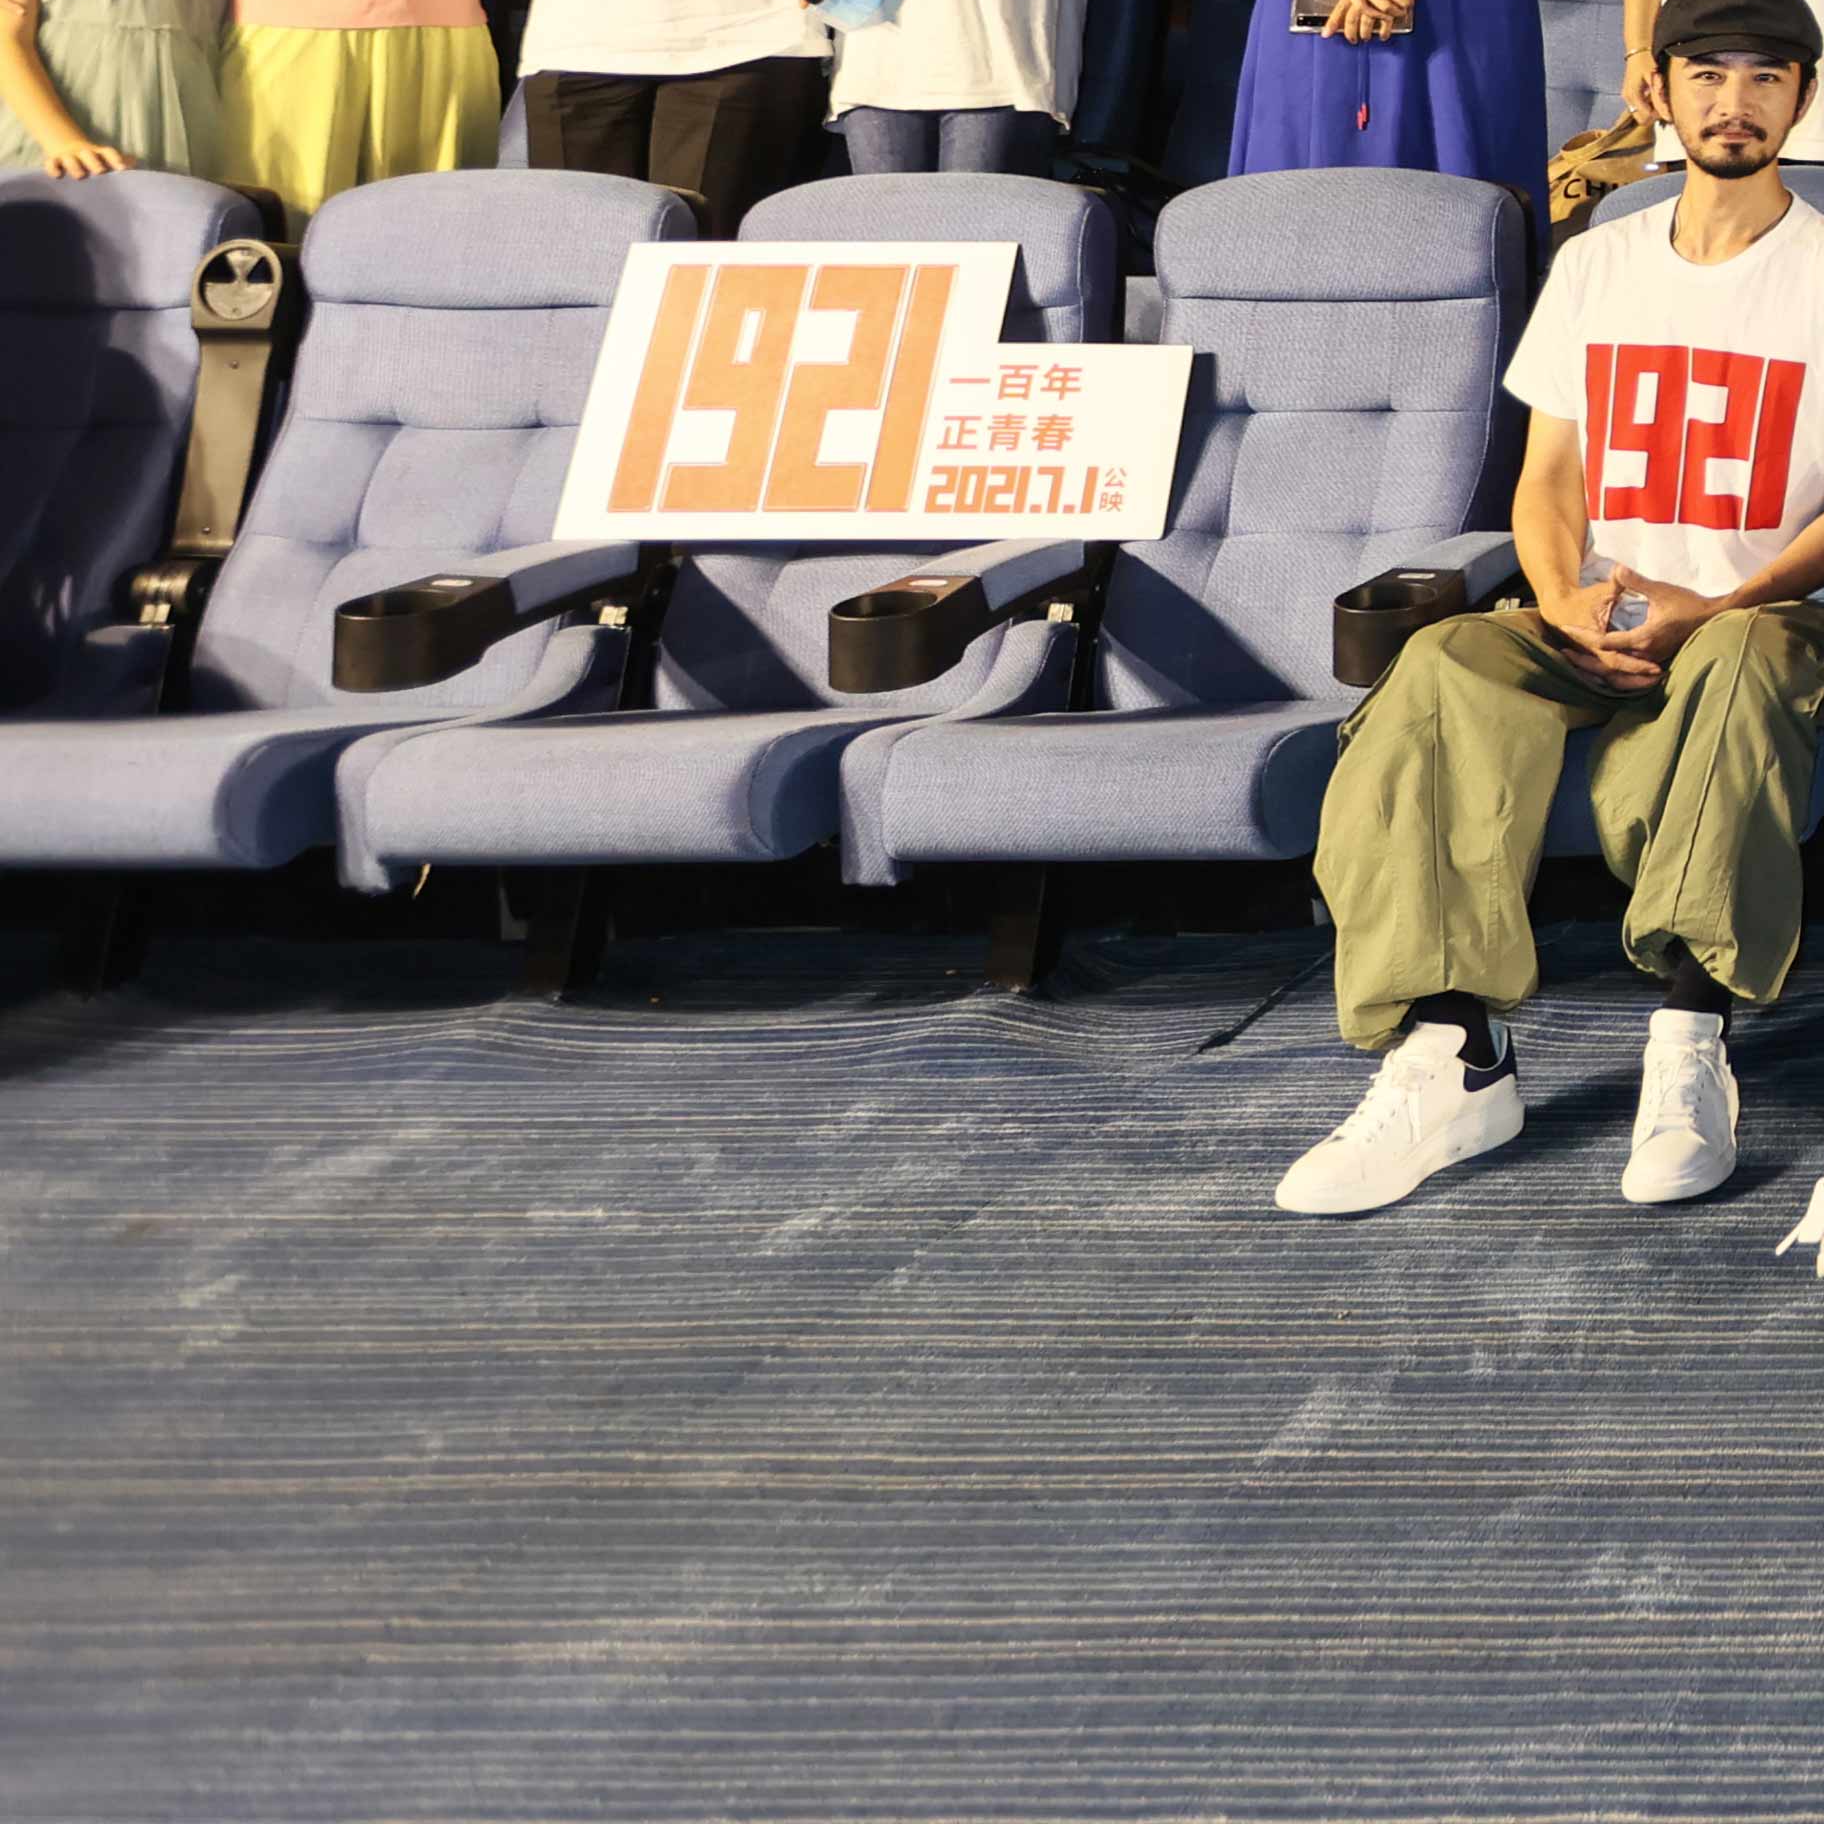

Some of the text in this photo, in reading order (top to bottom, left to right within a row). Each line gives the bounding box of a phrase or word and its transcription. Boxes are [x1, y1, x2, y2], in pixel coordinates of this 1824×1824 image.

[607, 263, 960, 512] 1921
[949, 363, 1083, 401] 一百年
[936, 414, 1075, 451] 正青春
[1585, 343, 1807, 531] 1921
[925, 466, 1099, 514] 2021.7.1
